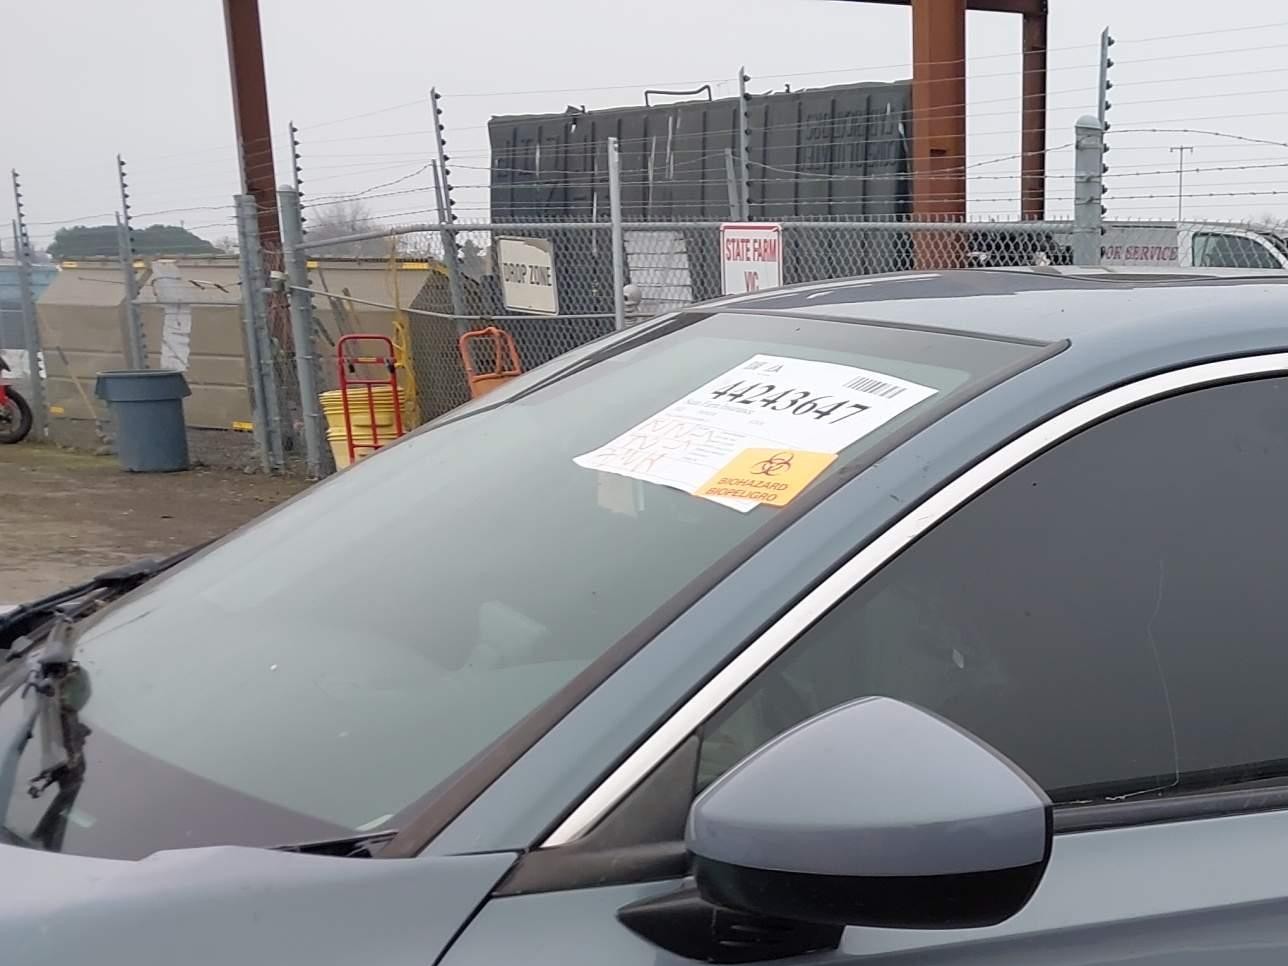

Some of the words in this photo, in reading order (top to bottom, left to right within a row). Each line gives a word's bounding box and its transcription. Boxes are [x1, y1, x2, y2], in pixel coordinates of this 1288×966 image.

[726, 238, 750, 261] STATE
[753, 239, 776, 262] FARM
[1124, 245, 1179, 260] SERVICE
[711, 379, 872, 424] 44243647
[718, 477, 788, 491] BIOHAZARD
[705, 487, 777, 501] BIOPELIGRO
